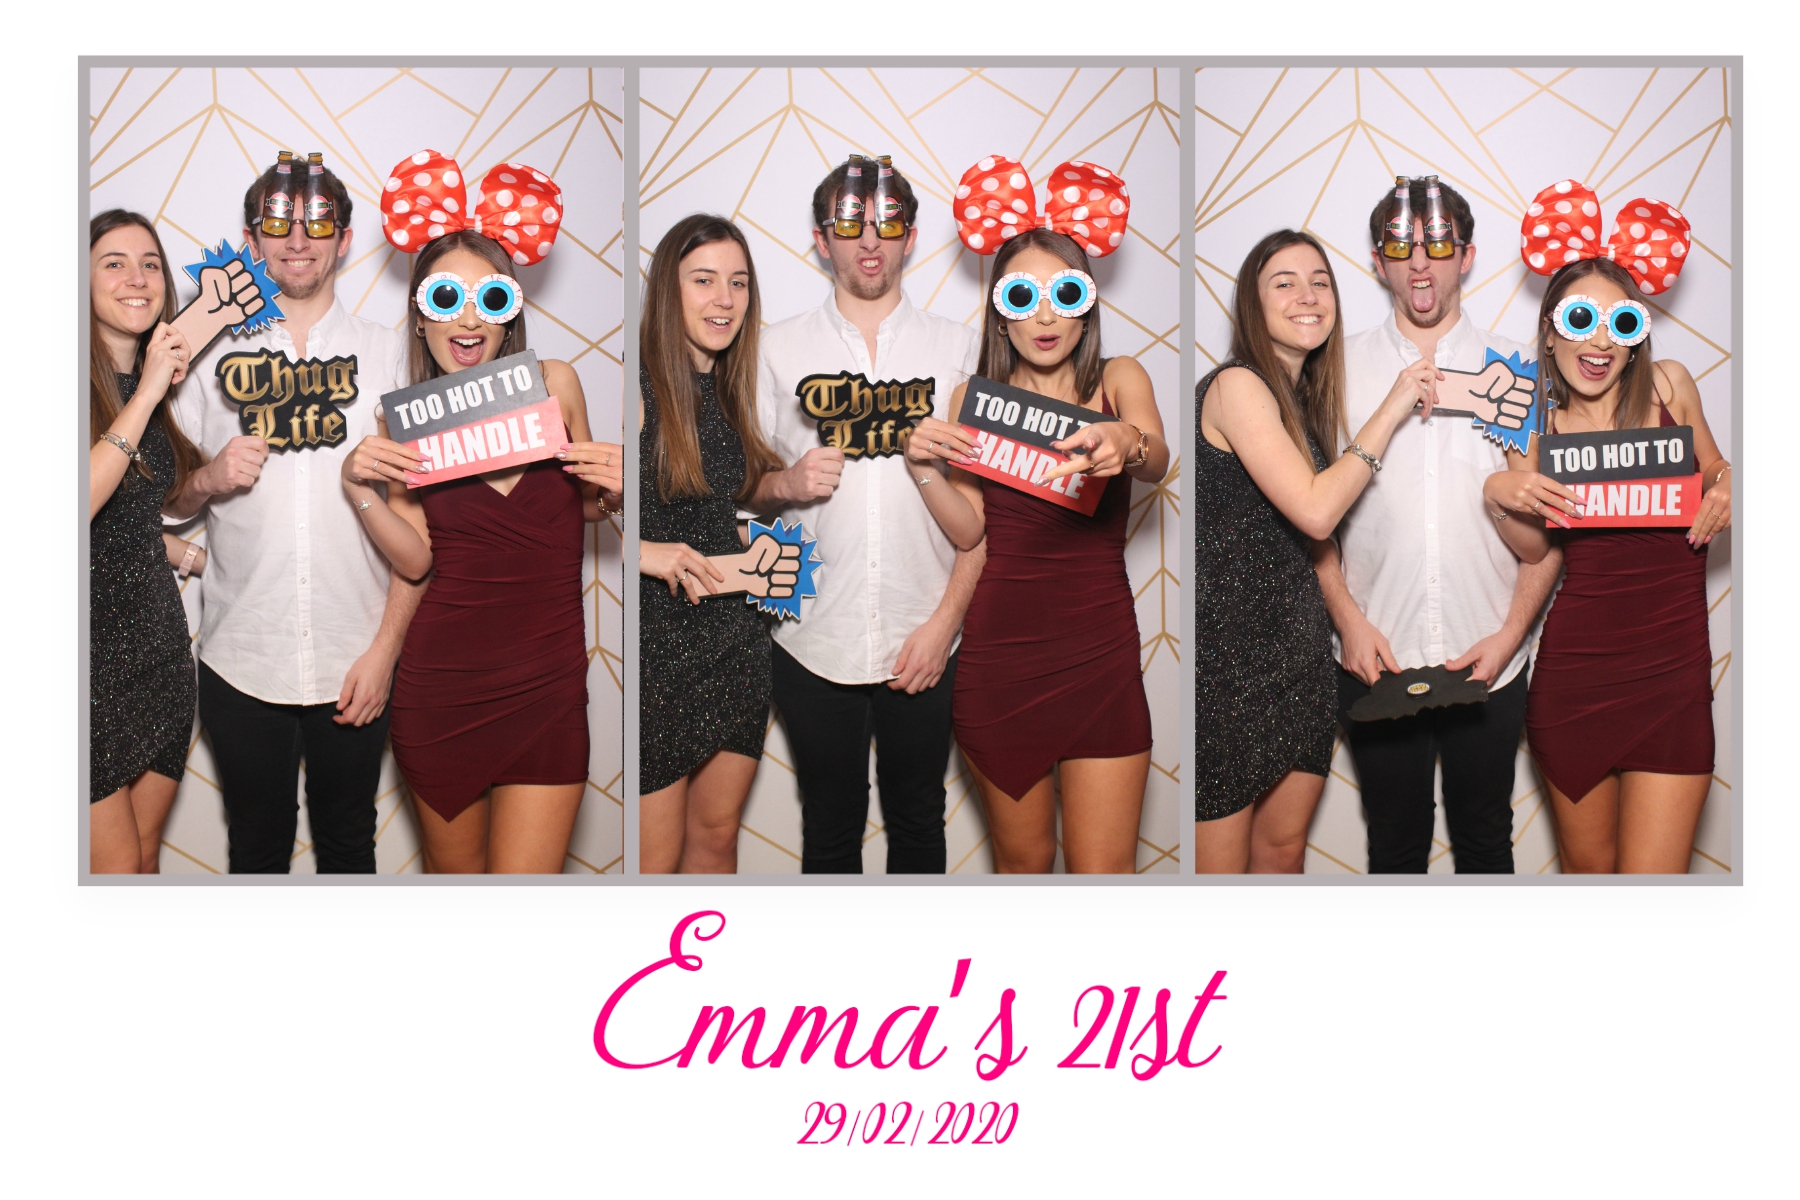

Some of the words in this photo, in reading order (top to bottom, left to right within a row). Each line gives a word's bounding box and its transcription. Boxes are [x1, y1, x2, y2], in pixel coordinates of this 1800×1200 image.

[220, 353, 355, 405] Thug
[394, 397, 445, 430] TOO
[446, 376, 495, 416] HOT
[497, 364, 533, 396] TO
[801, 376, 932, 421] Thug
[243, 403, 345, 447] Life
[974, 391, 1021, 426] TOO
[1022, 406, 1074, 440] HOT
[417, 412, 546, 472] HANDLE
[1550, 446, 1597, 473] TOO
[1602, 441, 1649, 469] HOT
[1653, 438, 1684, 464] TO
